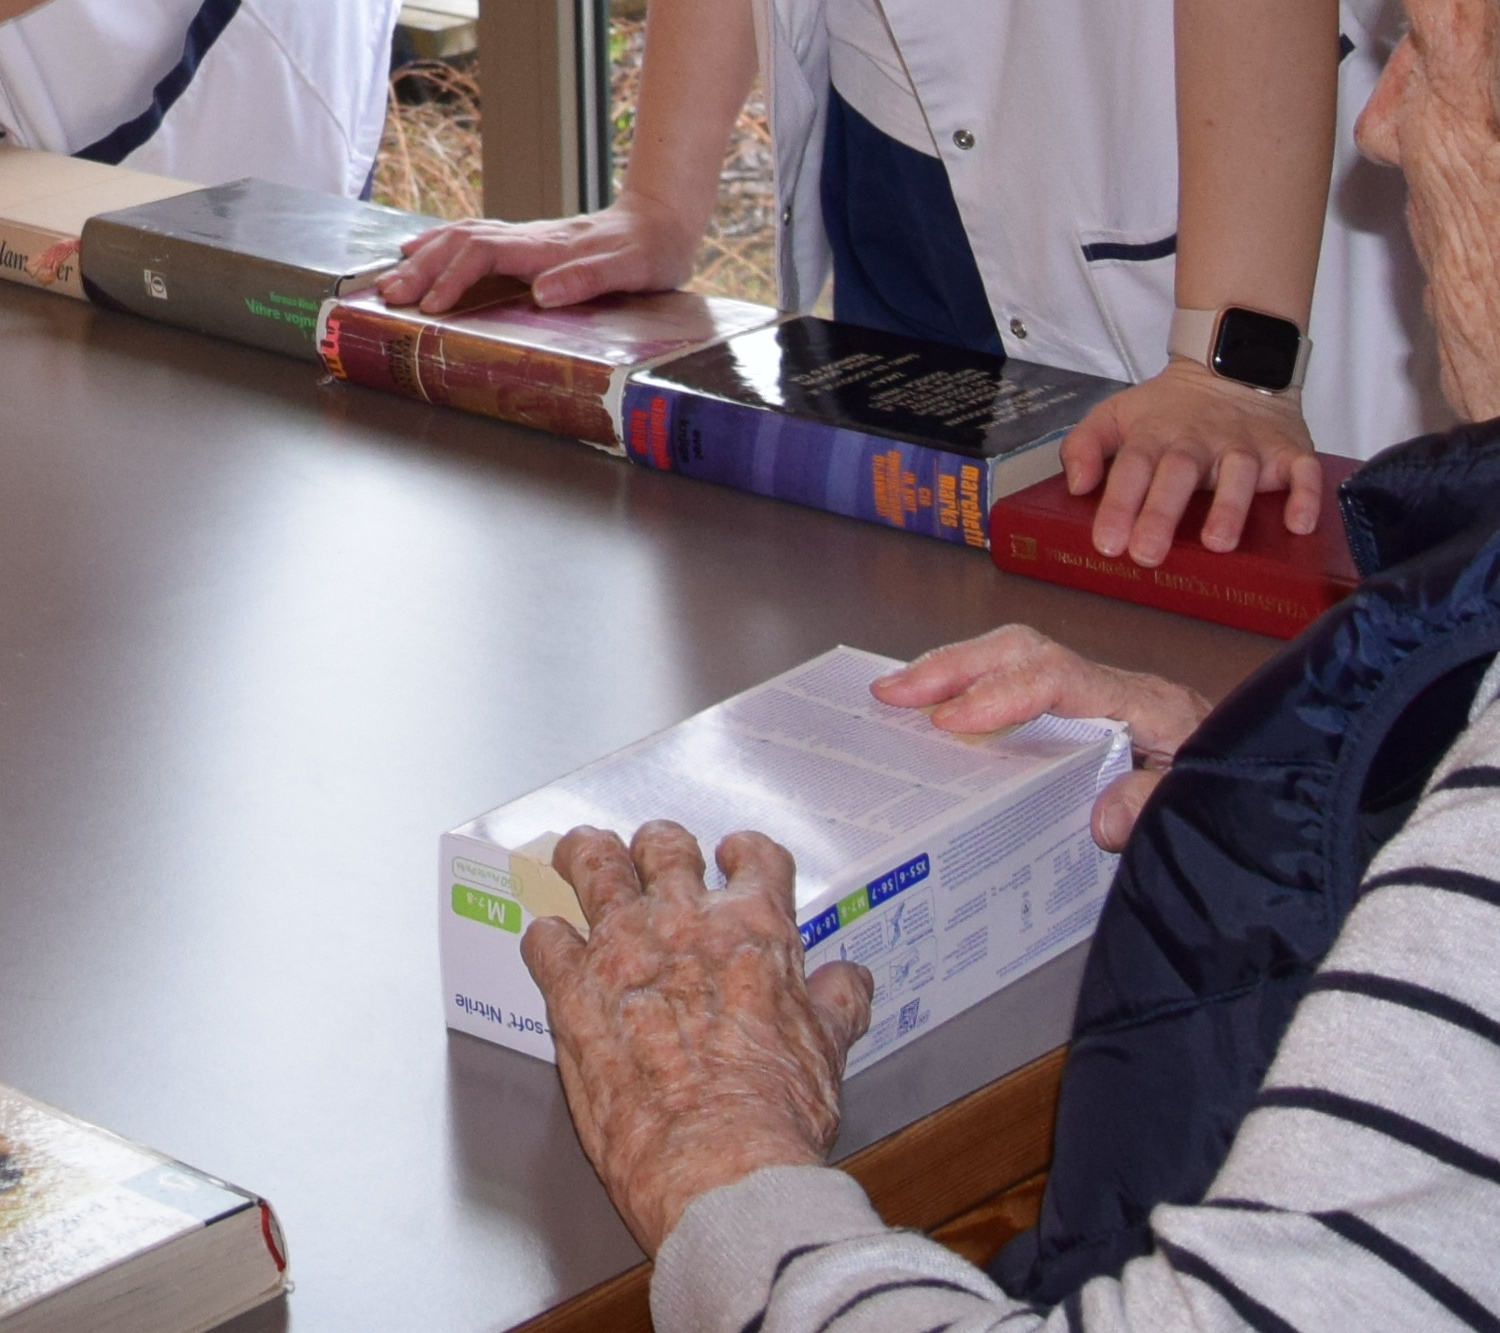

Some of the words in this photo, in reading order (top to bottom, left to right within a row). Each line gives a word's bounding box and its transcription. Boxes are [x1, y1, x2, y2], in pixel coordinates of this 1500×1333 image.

[939, 474, 959, 528] marks
[960, 464, 986, 548] marchetti
[1154, 570, 1220, 599] KMEČKA
[1226, 586, 1311, 619] DINASTIJA
[463, 890, 485, 908] 7-8
[485, 898, 506, 924] M
[454, 993, 502, 1024] Nitrile
[507, 1012, 551, 1036] -soft
